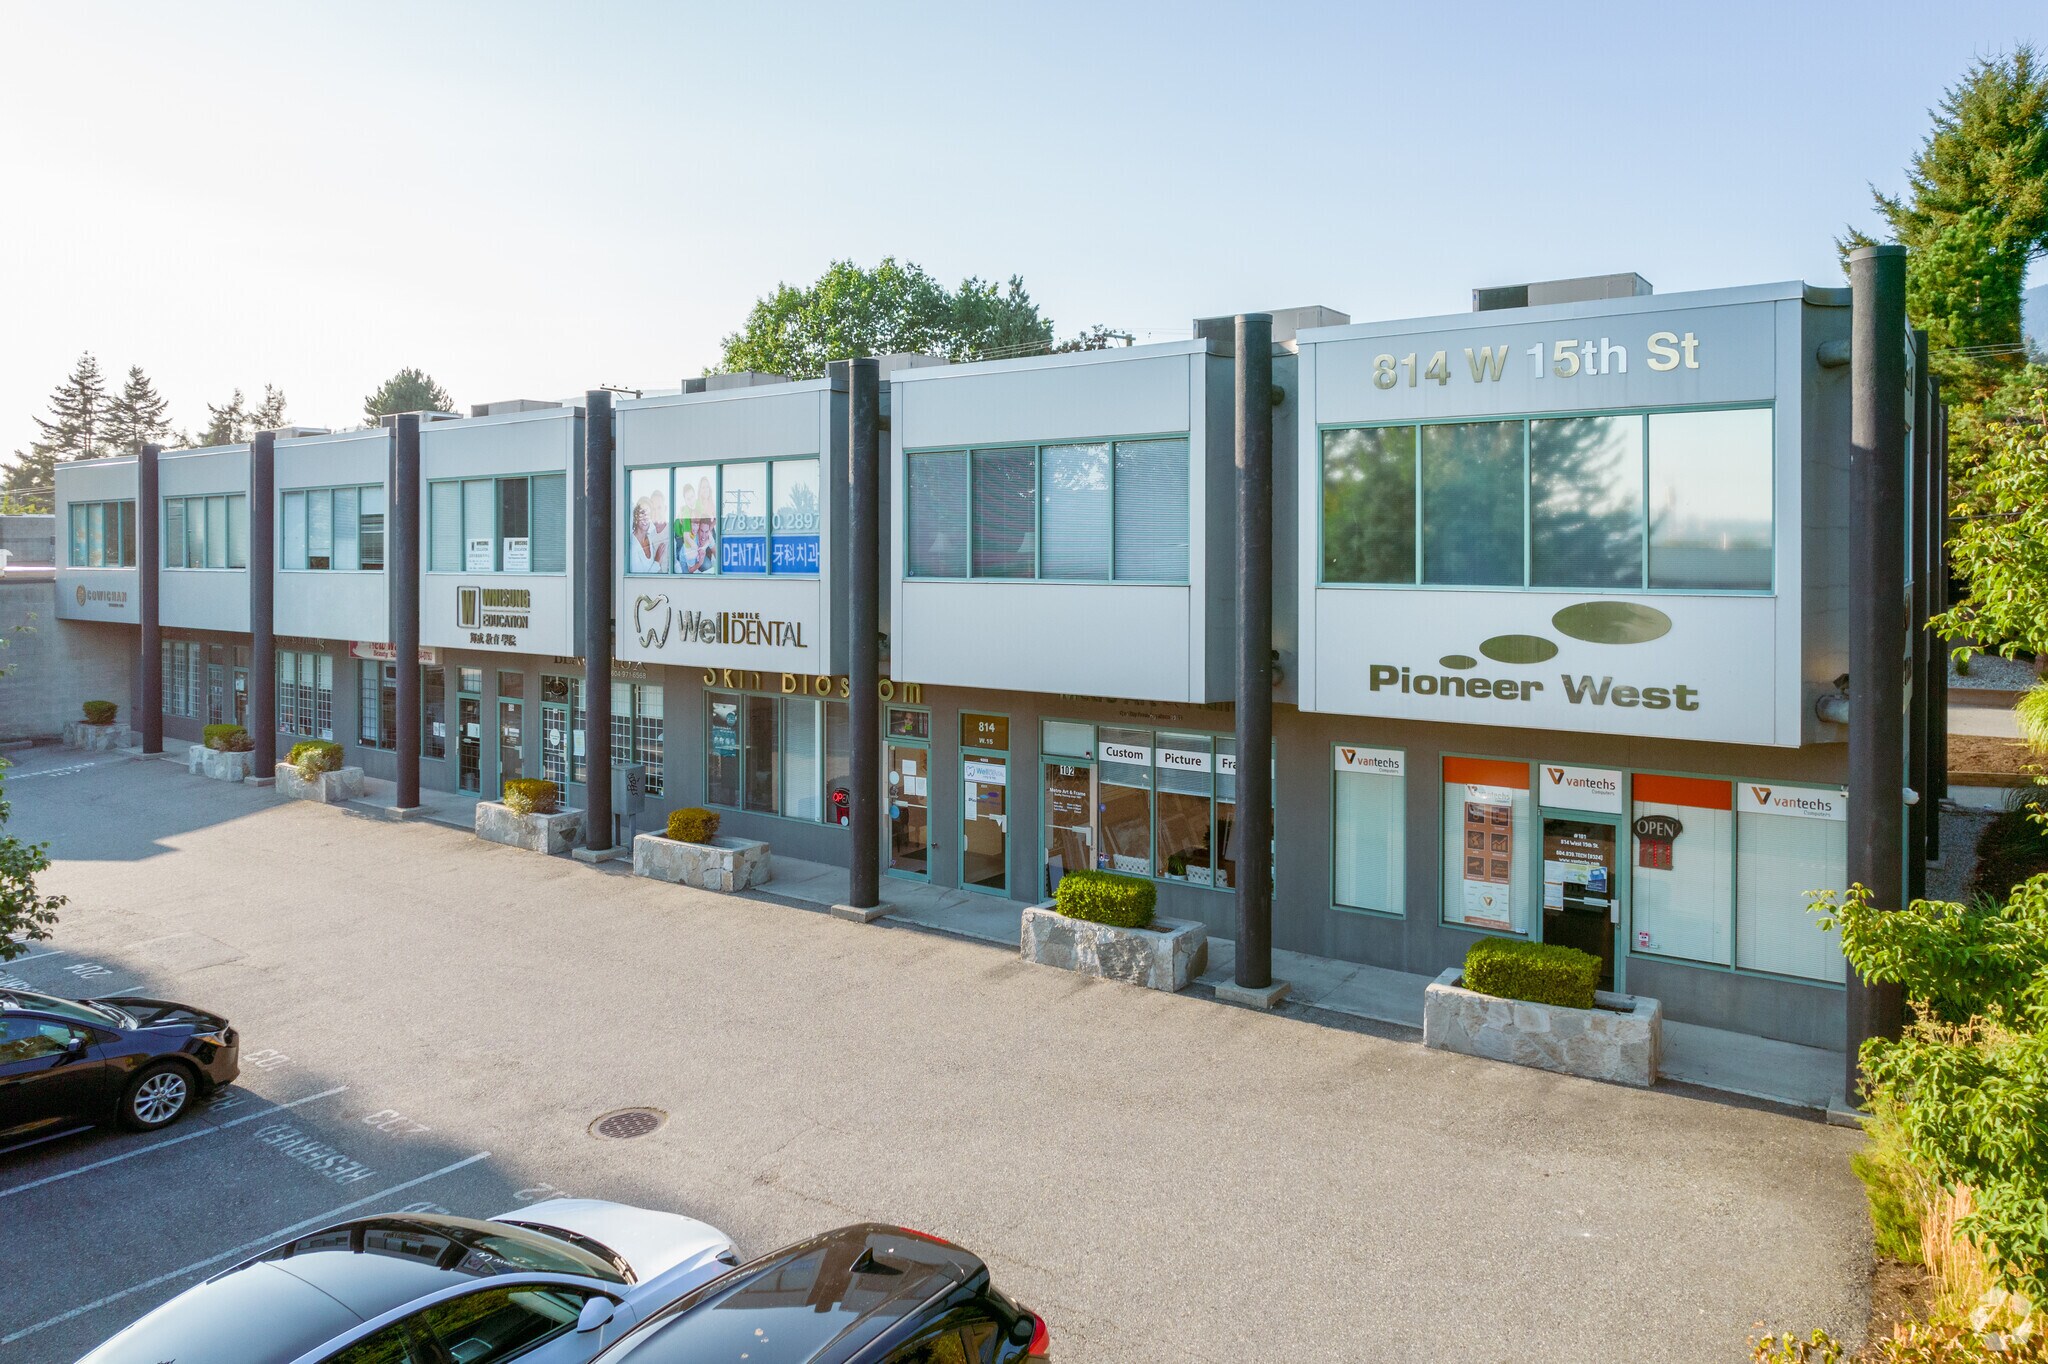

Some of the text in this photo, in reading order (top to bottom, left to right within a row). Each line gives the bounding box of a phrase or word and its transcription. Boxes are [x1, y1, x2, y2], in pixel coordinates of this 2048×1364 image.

[1372, 332, 1699, 390] 814 W 15th St
[723, 543, 766, 566] DENTAL
[87, 590, 127, 602] COWICHAN
[482, 614, 529, 629] EDUCATION
[731, 612, 760, 620] SMILE
[731, 620, 808, 648] DENTAL
[781, 671, 921, 704] Blosom
[1369, 664, 1699, 711] Pioneer West
[978, 721, 995, 733] 814
[1106, 746, 1237, 770] Custom Picture Fra
[1358, 757, 1399, 768] vantechs
[1060, 765, 1074, 776] 102
[1566, 777, 1616, 791] vantechs
[1774, 797, 1832, 812] vantechs
[1804, 810, 1831, 818] Computers
[1637, 820, 1674, 837] OPEN
[253, 1122, 378, 1186] RESERVED
